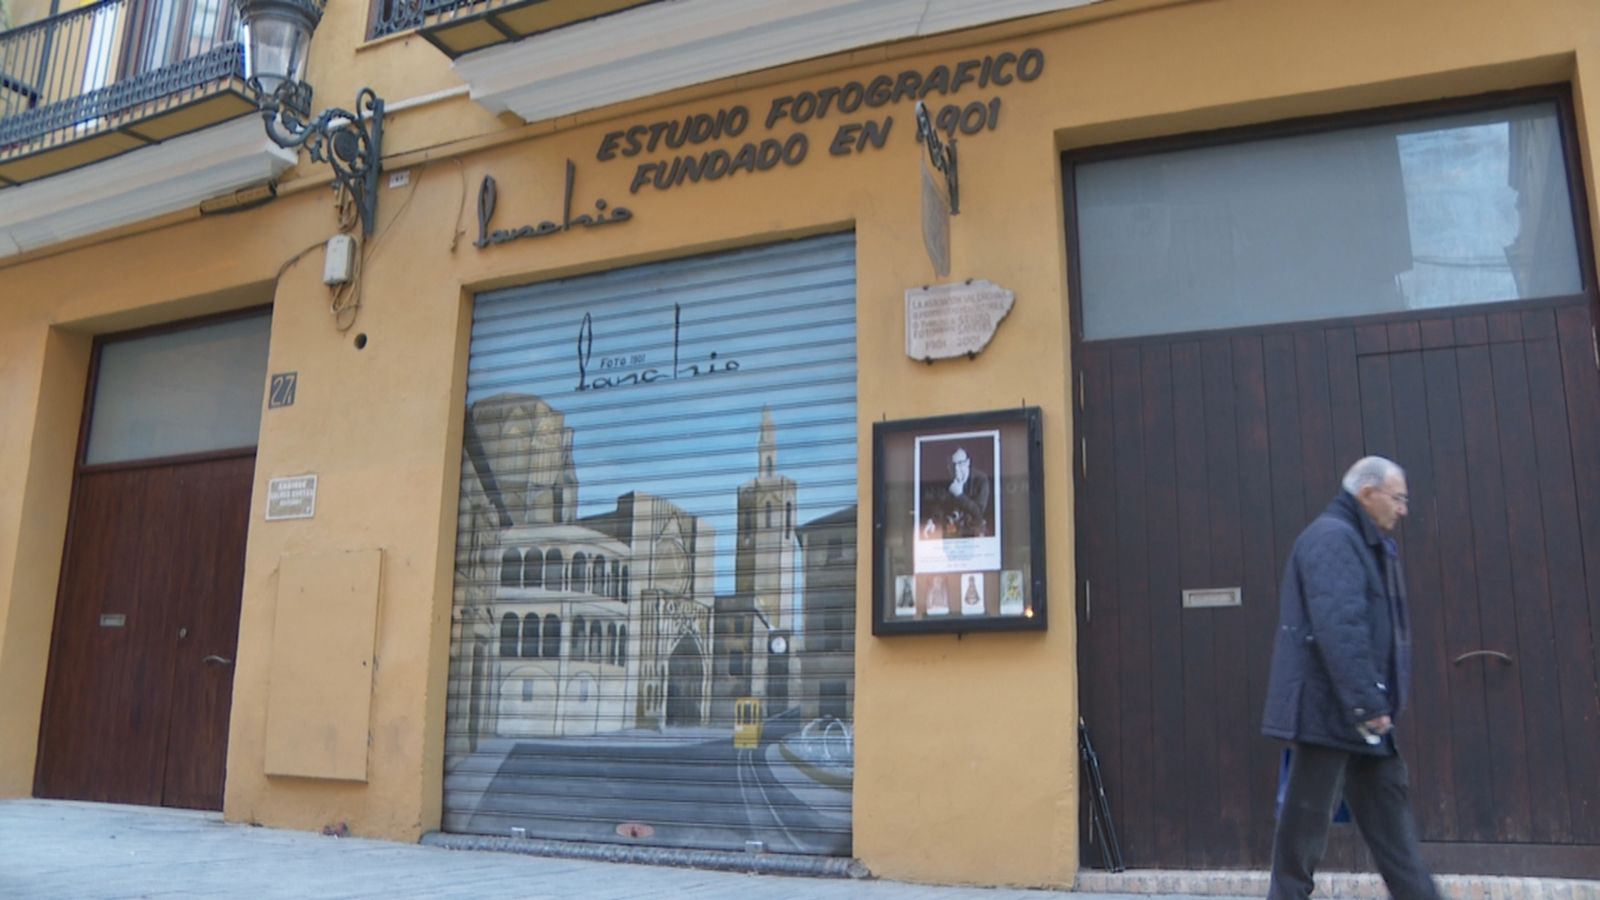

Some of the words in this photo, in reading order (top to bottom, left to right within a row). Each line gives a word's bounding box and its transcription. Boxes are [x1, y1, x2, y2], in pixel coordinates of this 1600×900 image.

[597, 106, 749, 161] ESTUDIO
[765, 48, 1044, 130] FOTOGRAFICO
[630, 133, 808, 193] FUNDADO
[829, 118, 892, 156] EN
[600, 356, 626, 369] FOTO
[271, 374, 296, 405] 27
